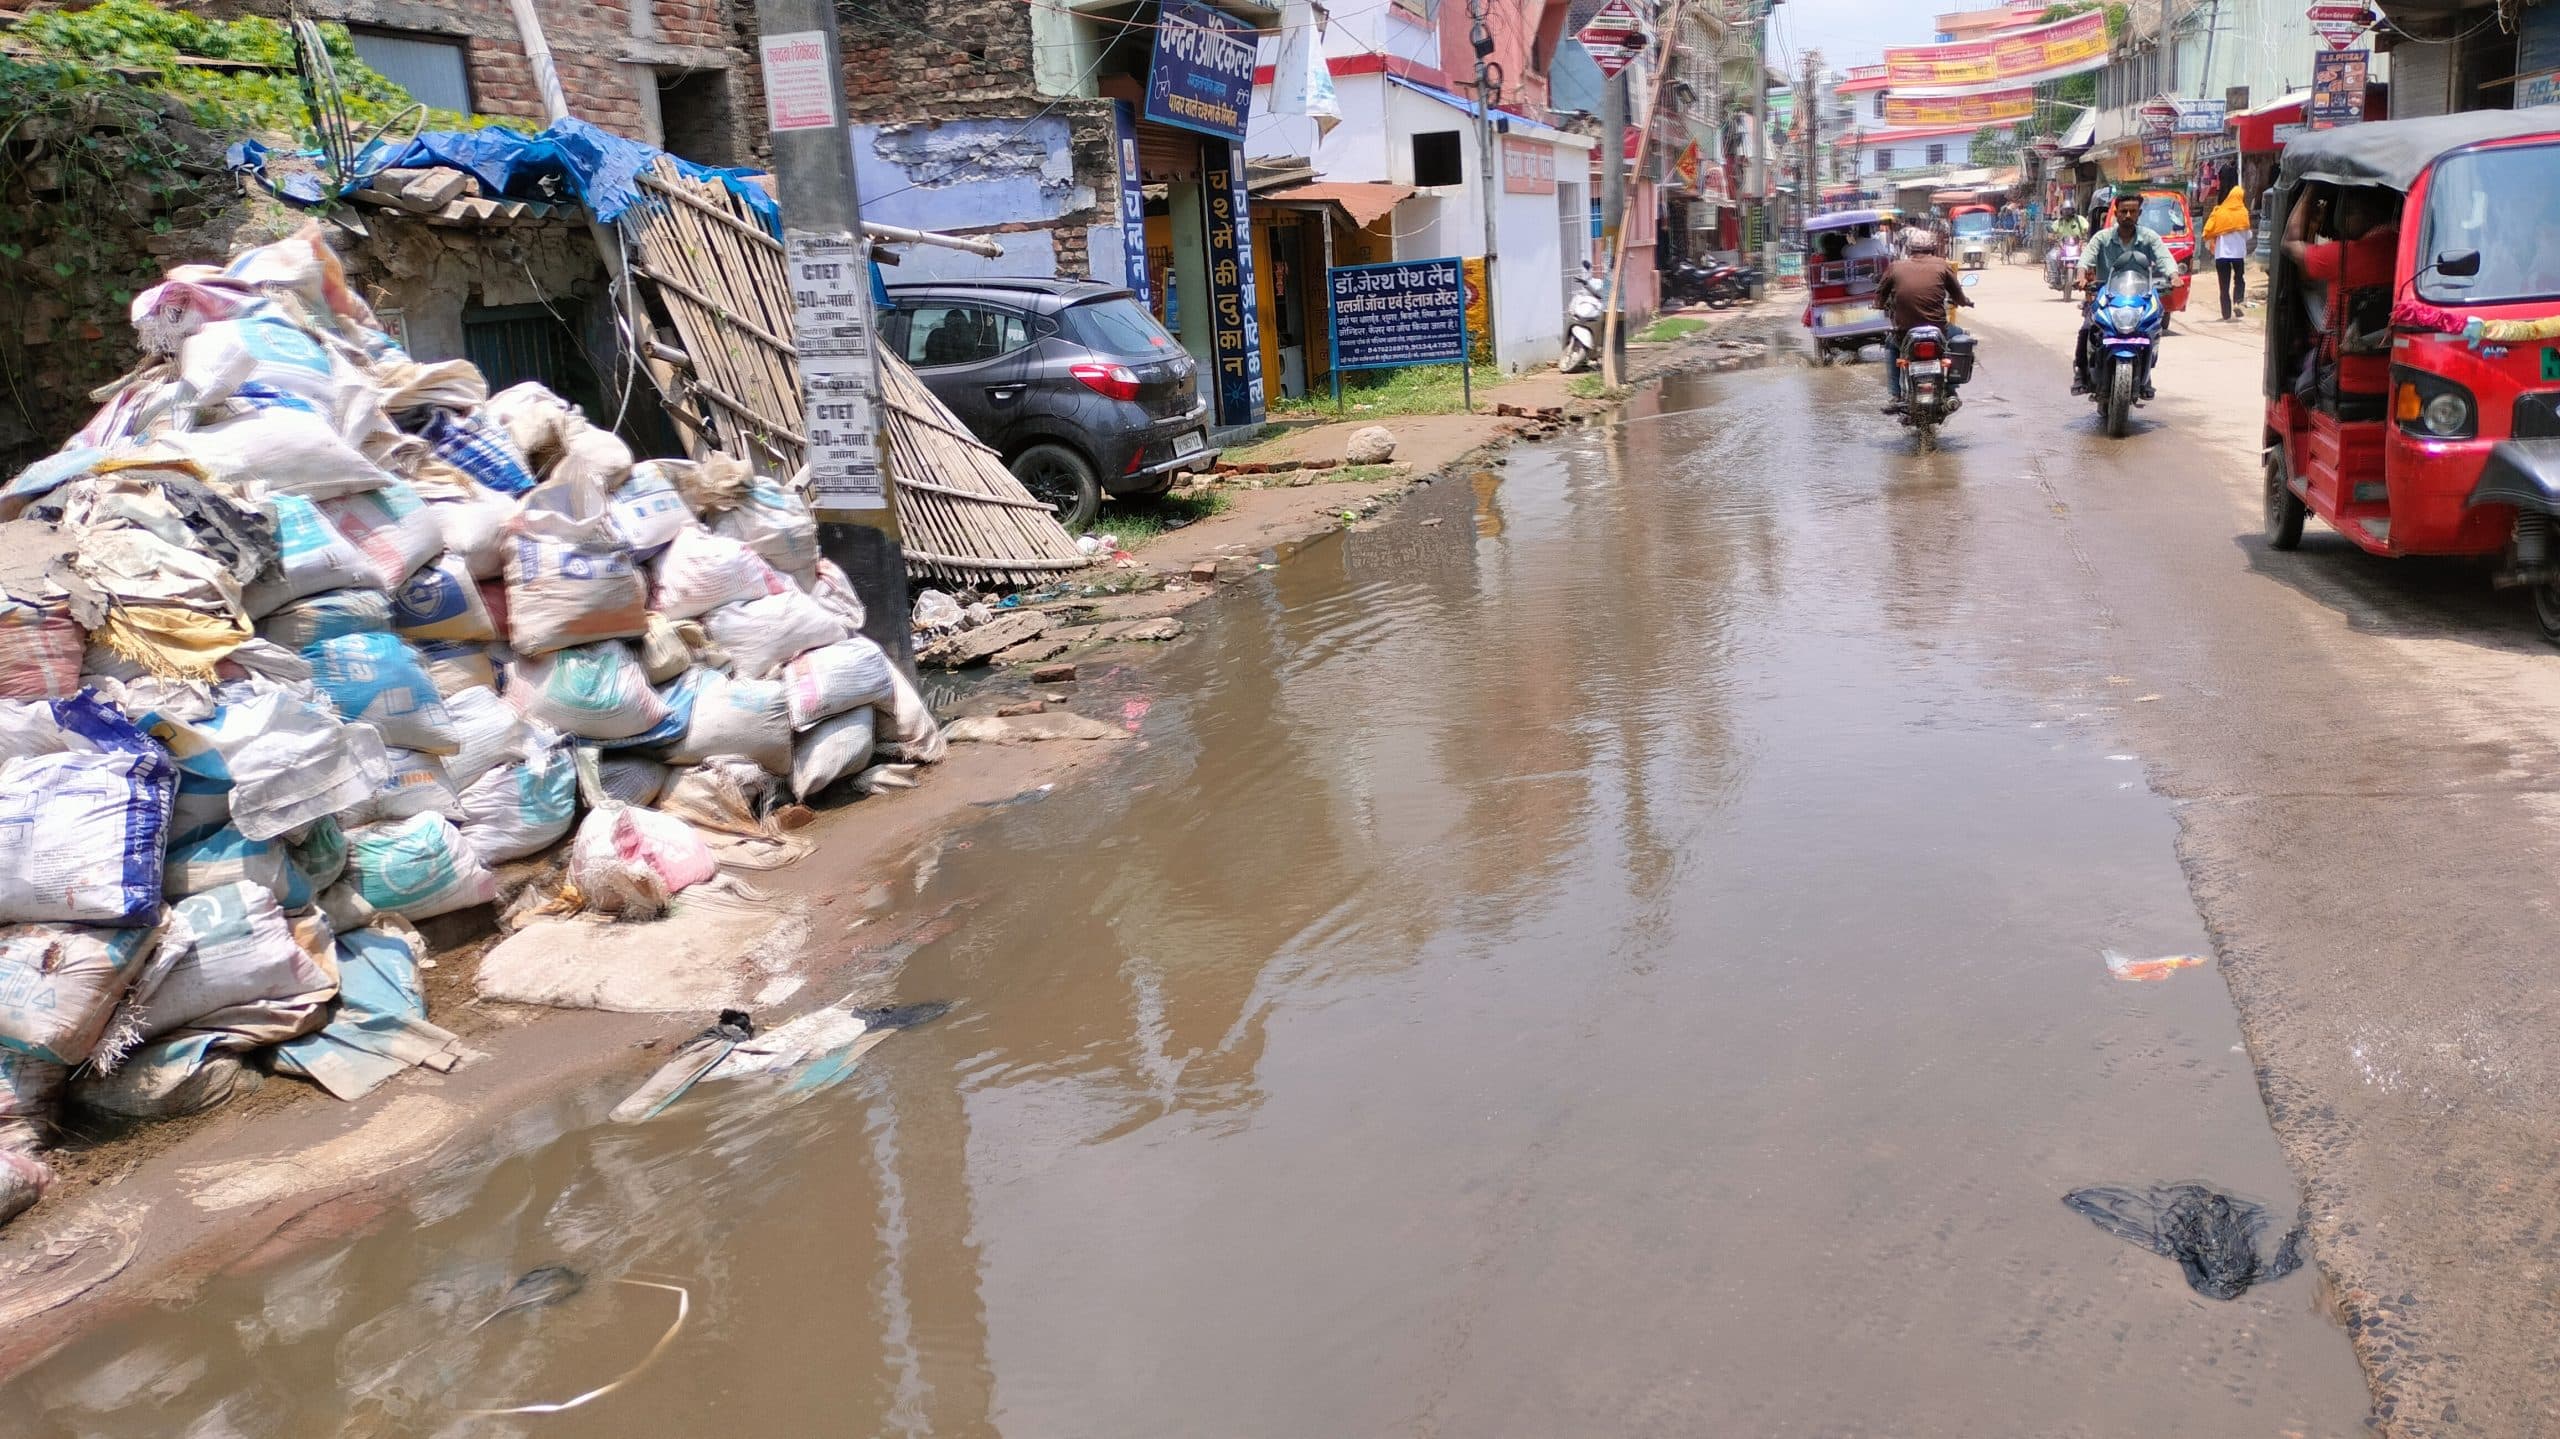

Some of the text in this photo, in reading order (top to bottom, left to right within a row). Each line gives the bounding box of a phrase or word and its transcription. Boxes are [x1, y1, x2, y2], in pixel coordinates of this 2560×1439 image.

[1160, 11, 1198, 62] चन्दन
[1168, 93, 1185, 114] पावर
[1184, 93, 1198, 118] वाले
[802, 264, 840, 280] CTET
[1396, 266, 1425, 289] पैथ
[1426, 263, 1456, 286] लैब
[1336, 294, 1364, 313] एलर्जी
[1388, 292, 1403, 310] एवं
[1404, 290, 1434, 311] ईलाज
[1435, 288, 1459, 305] सेंटर
[817, 404, 854, 420] CTET
